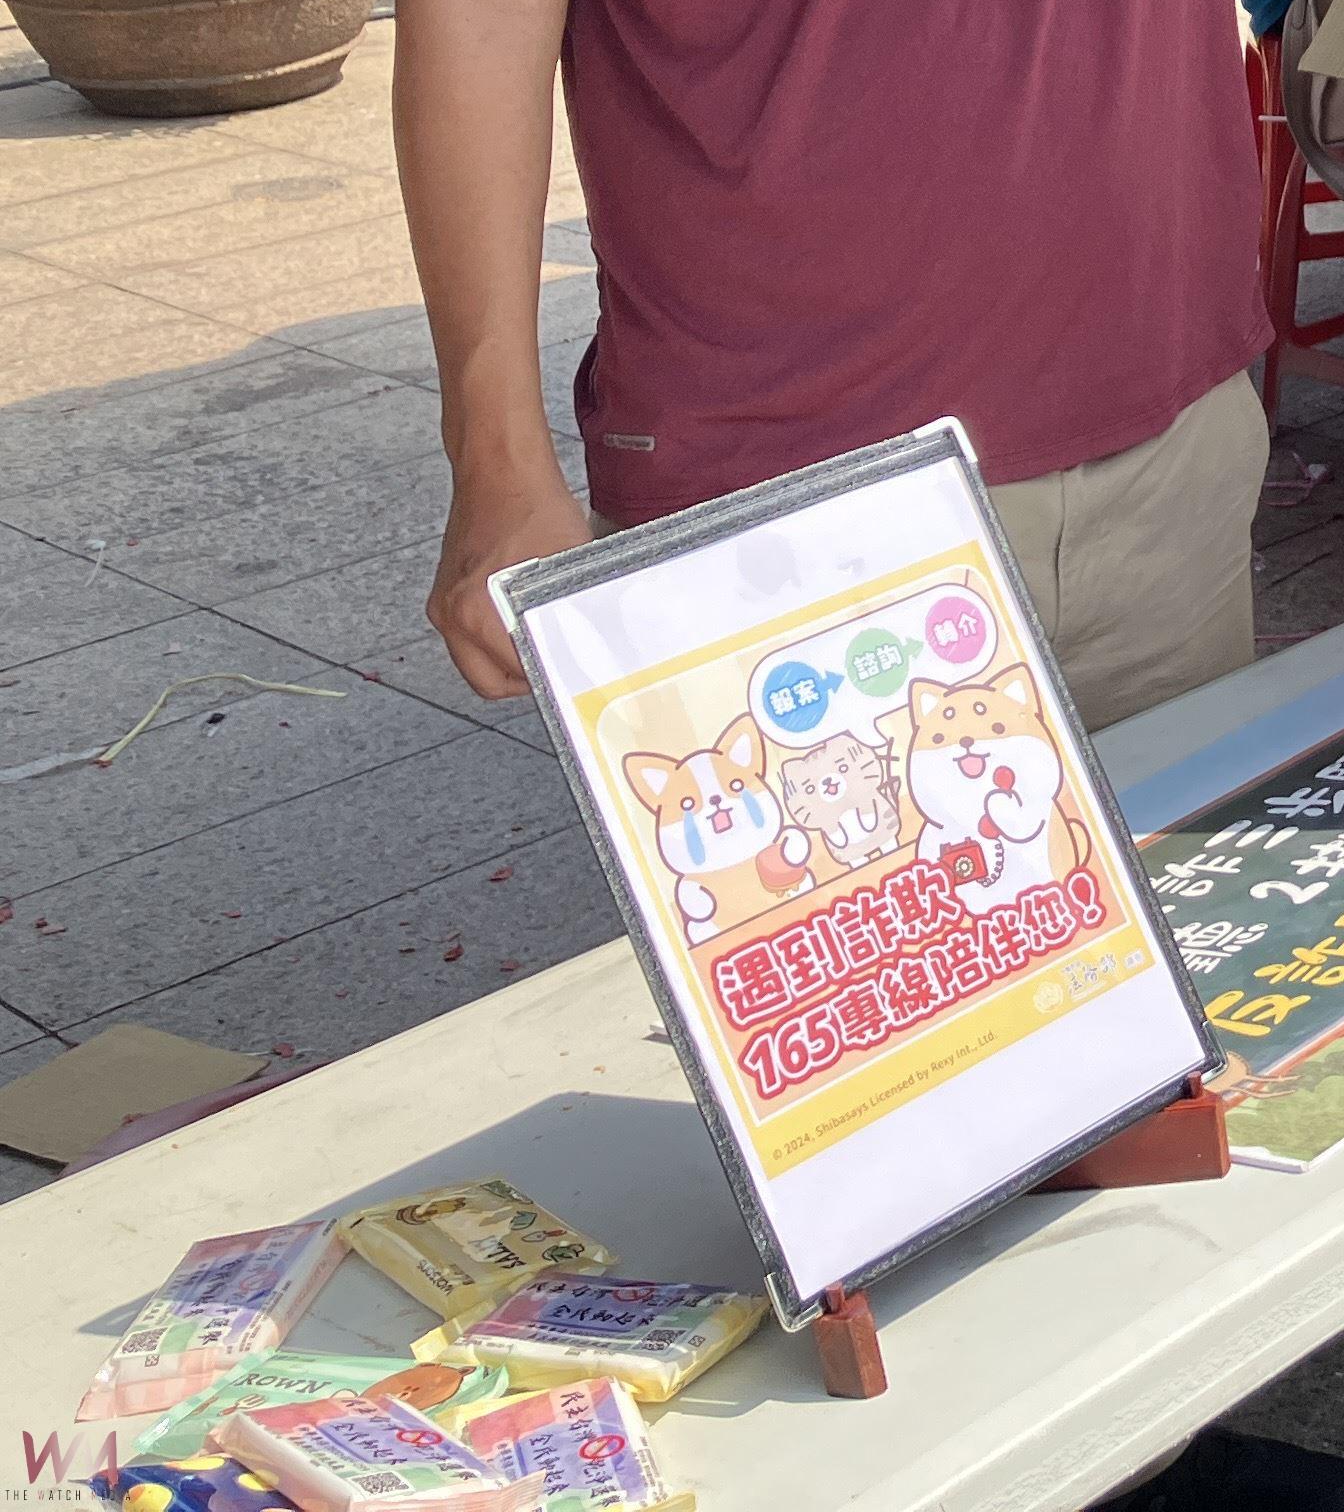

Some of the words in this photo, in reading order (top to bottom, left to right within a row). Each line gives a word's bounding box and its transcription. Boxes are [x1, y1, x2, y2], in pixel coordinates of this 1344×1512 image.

[932, 612, 980, 646] 轉介
[852, 643, 904, 681] 諮詢
[769, 679, 821, 717] 報案
[717, 866, 960, 1022] 遇到詐欺
[746, 872, 1102, 1093] 165專線陪伴您！
[815, 1103, 869, 1138] Shibasays
[868, 1075, 916, 1109] Licensed
[914, 1067, 930, 1084] by
[929, 1056, 956, 1076] Rexy
[233, 1373, 333, 1394] ROWN
